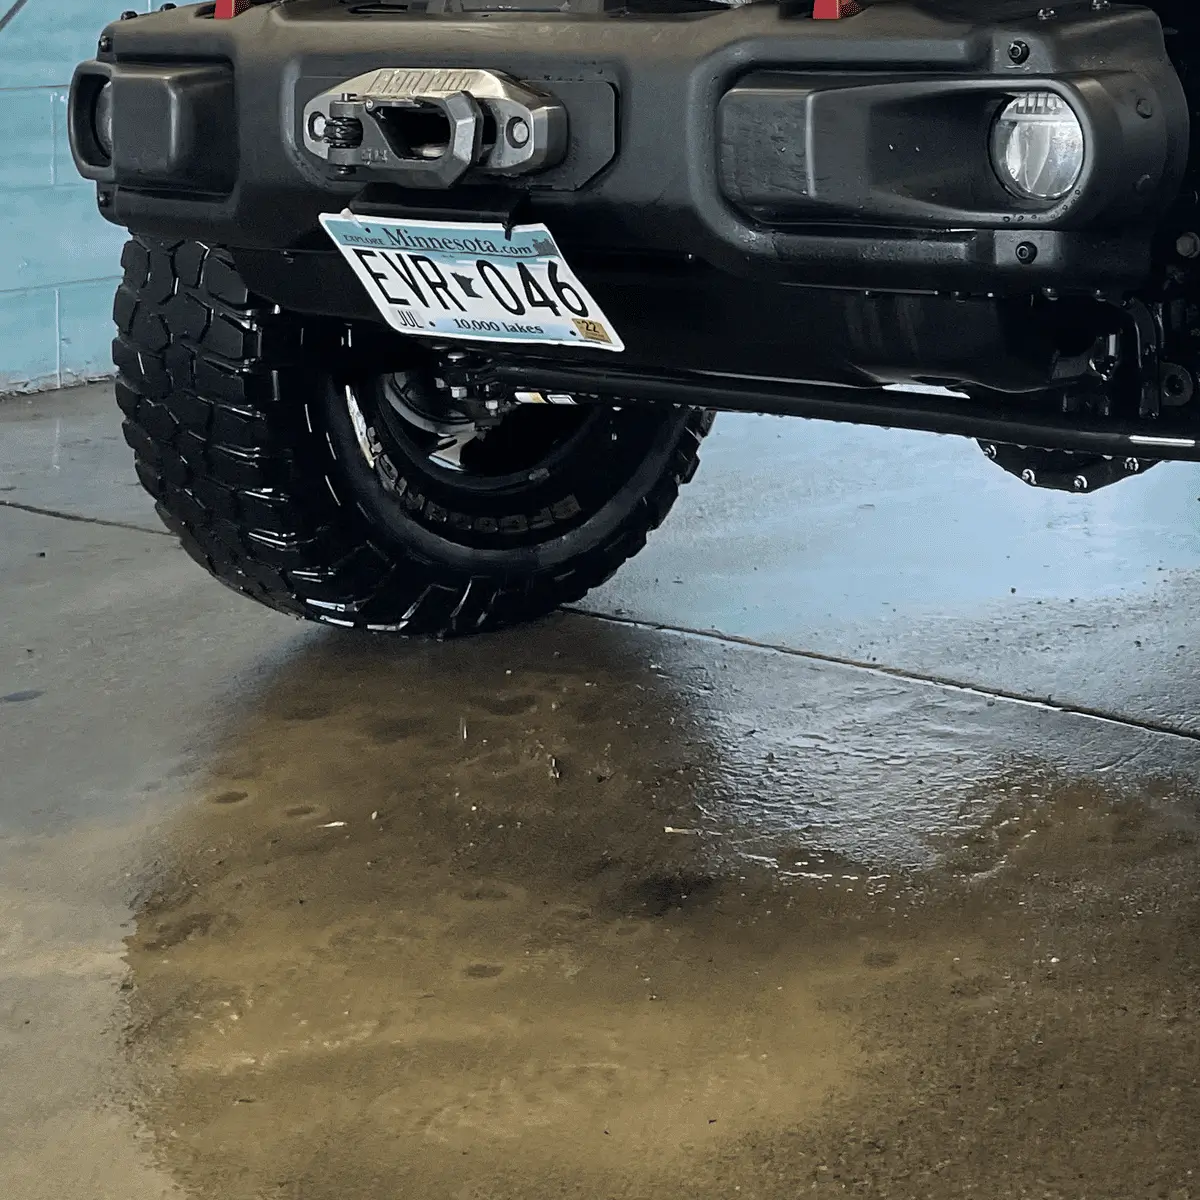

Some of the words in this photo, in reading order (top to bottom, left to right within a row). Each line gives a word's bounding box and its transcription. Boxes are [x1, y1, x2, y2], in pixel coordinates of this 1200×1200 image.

[343, 234, 387, 246] EXPLORE
[352, 248, 467, 312] EVR
[475, 259, 590, 318] 046
[397, 309, 425, 329] JUL
[453, 317, 500, 332] 10,000
[501, 321, 545, 334] lakes
[581, 320, 600, 334] 22
